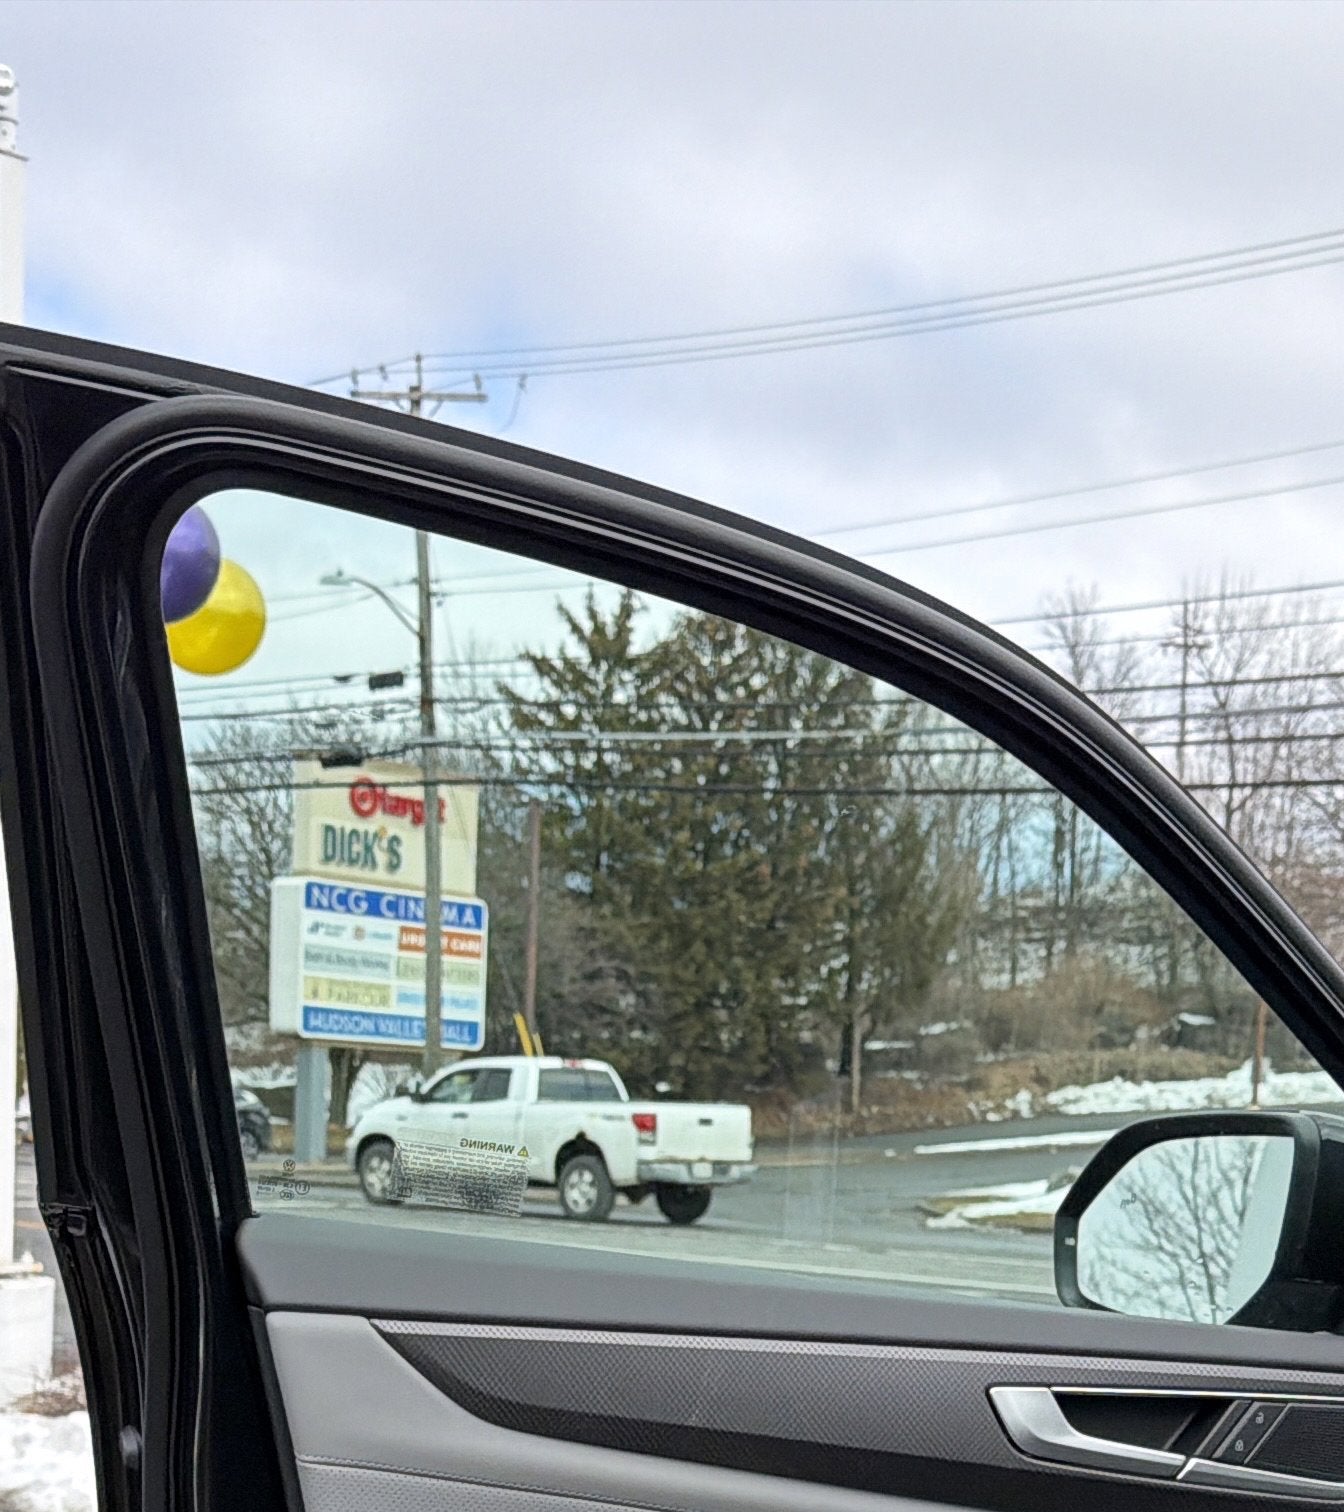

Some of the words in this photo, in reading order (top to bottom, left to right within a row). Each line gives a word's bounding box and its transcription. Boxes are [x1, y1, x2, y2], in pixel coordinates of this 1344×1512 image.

[322, 824, 403, 875] DICK'S
[310, 884, 369, 914] NCG
[379, 895, 477, 926] CINMA
[377, 1016, 426, 1040] VALLE
